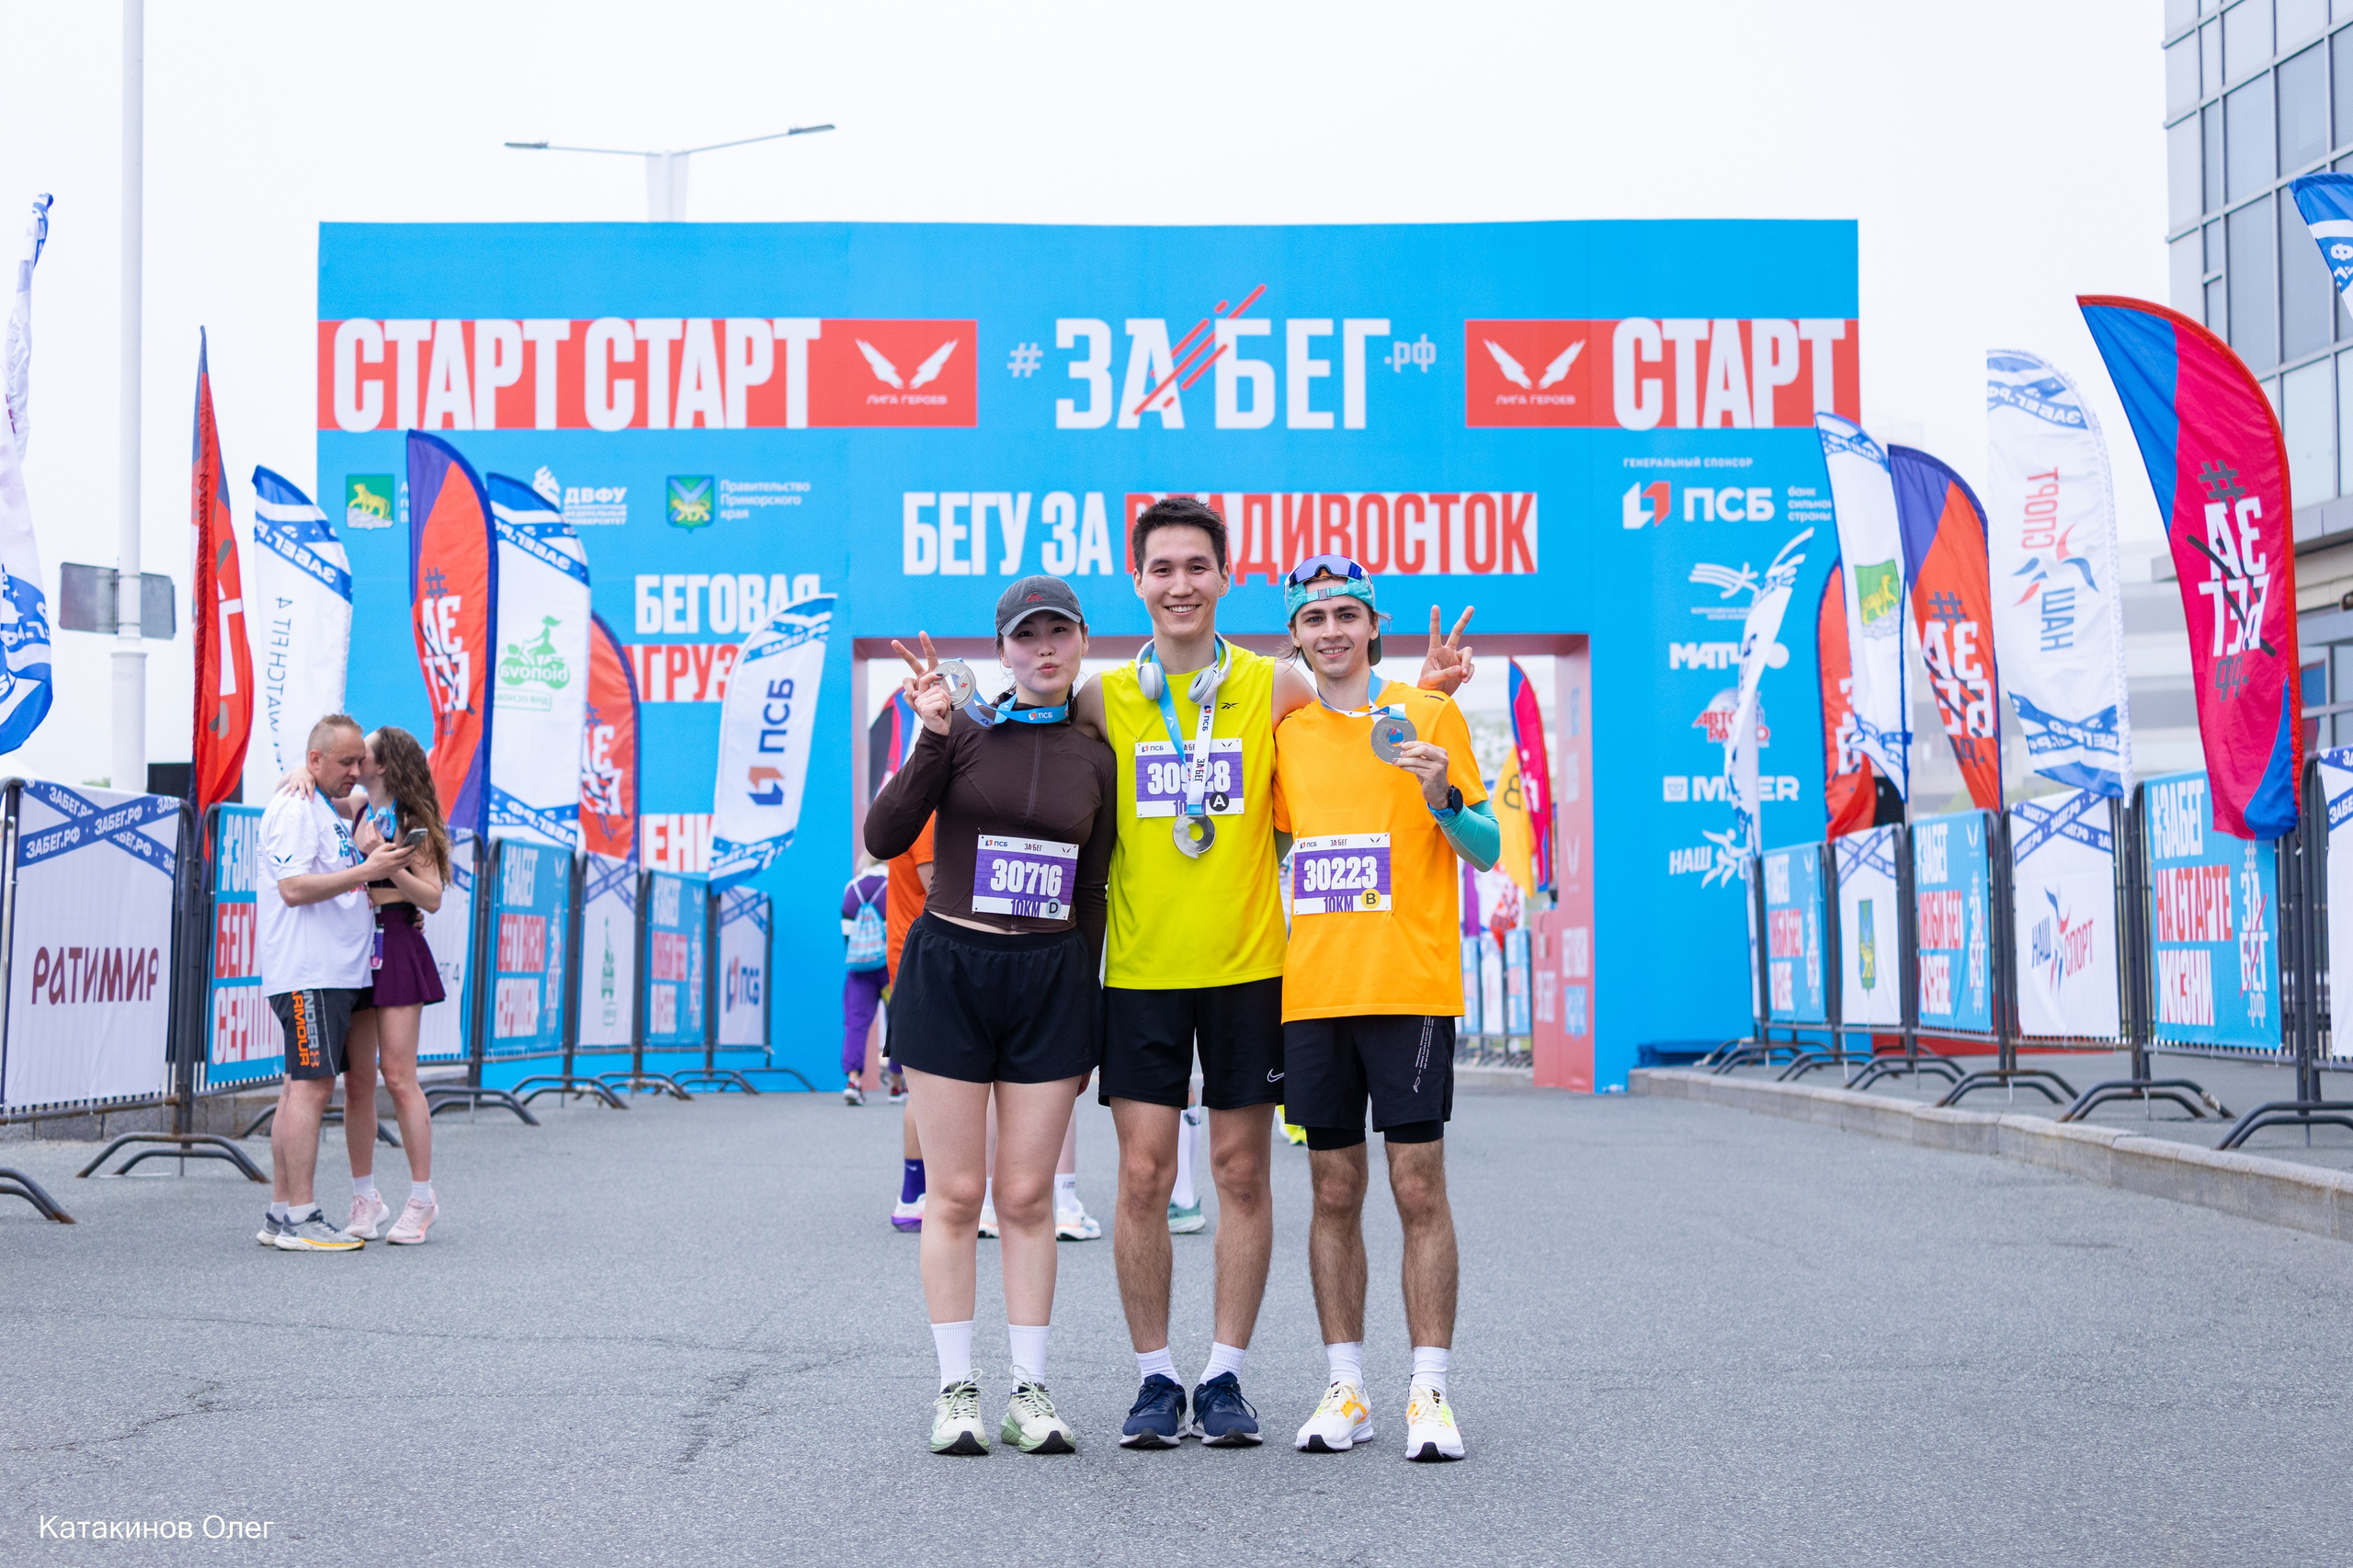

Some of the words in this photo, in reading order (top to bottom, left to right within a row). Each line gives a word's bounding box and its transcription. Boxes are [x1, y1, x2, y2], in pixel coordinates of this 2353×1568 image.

[334, 317, 571, 432] СТАРТ
[585, 316, 822, 431] СТАРТ
[1613, 316, 1847, 431] СТАРТ
[866, 393, 899, 404] ЛИГА
[901, 393, 948, 405] ГЕРОЕВ
[1495, 394, 1527, 405] ЛИГА
[1529, 394, 1576, 405] ГЕРОЕВ
[1623, 458, 1700, 468] ГЕНЕРАЛЬНЫЙ
[1704, 458, 1754, 468] СПОНСОР
[563, 487, 628, 505] ДВФУ
[720, 480, 811, 494] Правительство
[720, 494, 802, 507] Приморского
[1788, 485, 1816, 497] банк
[720, 509, 750, 521] края
[1684, 487, 1775, 522] ПСБ
[904, 492, 1032, 575] БЕГУ
[1041, 491, 1113, 575] ЗА
[1124, 492, 1538, 585] ДИВОСТОК
[758, 677, 795, 754] ПСБ
[1212, 794, 1226, 807] A
[95, 804, 143, 836] ЗАБЕГ.РФ
[2152, 778, 2205, 859] #ЗАБЕГ
[26, 825, 81, 859] ЗАБЕГ.РФ
[1303, 856, 1378, 892] 30223
[1668, 845, 1712, 876] НАШ
[990, 858, 1063, 898] 30716
[1049, 902, 1059, 914] D
[1366, 892, 1377, 905] B
[2156, 868, 2174, 942] НА
[2176, 864, 2233, 942] СТАРТЕ
[2031, 915, 2052, 969] НАШ
[2064, 917, 2094, 978] СПОРТ
[31, 946, 159, 1006] РАТИМИР
[2157, 949, 2215, 1027] ЖИЗНИ
